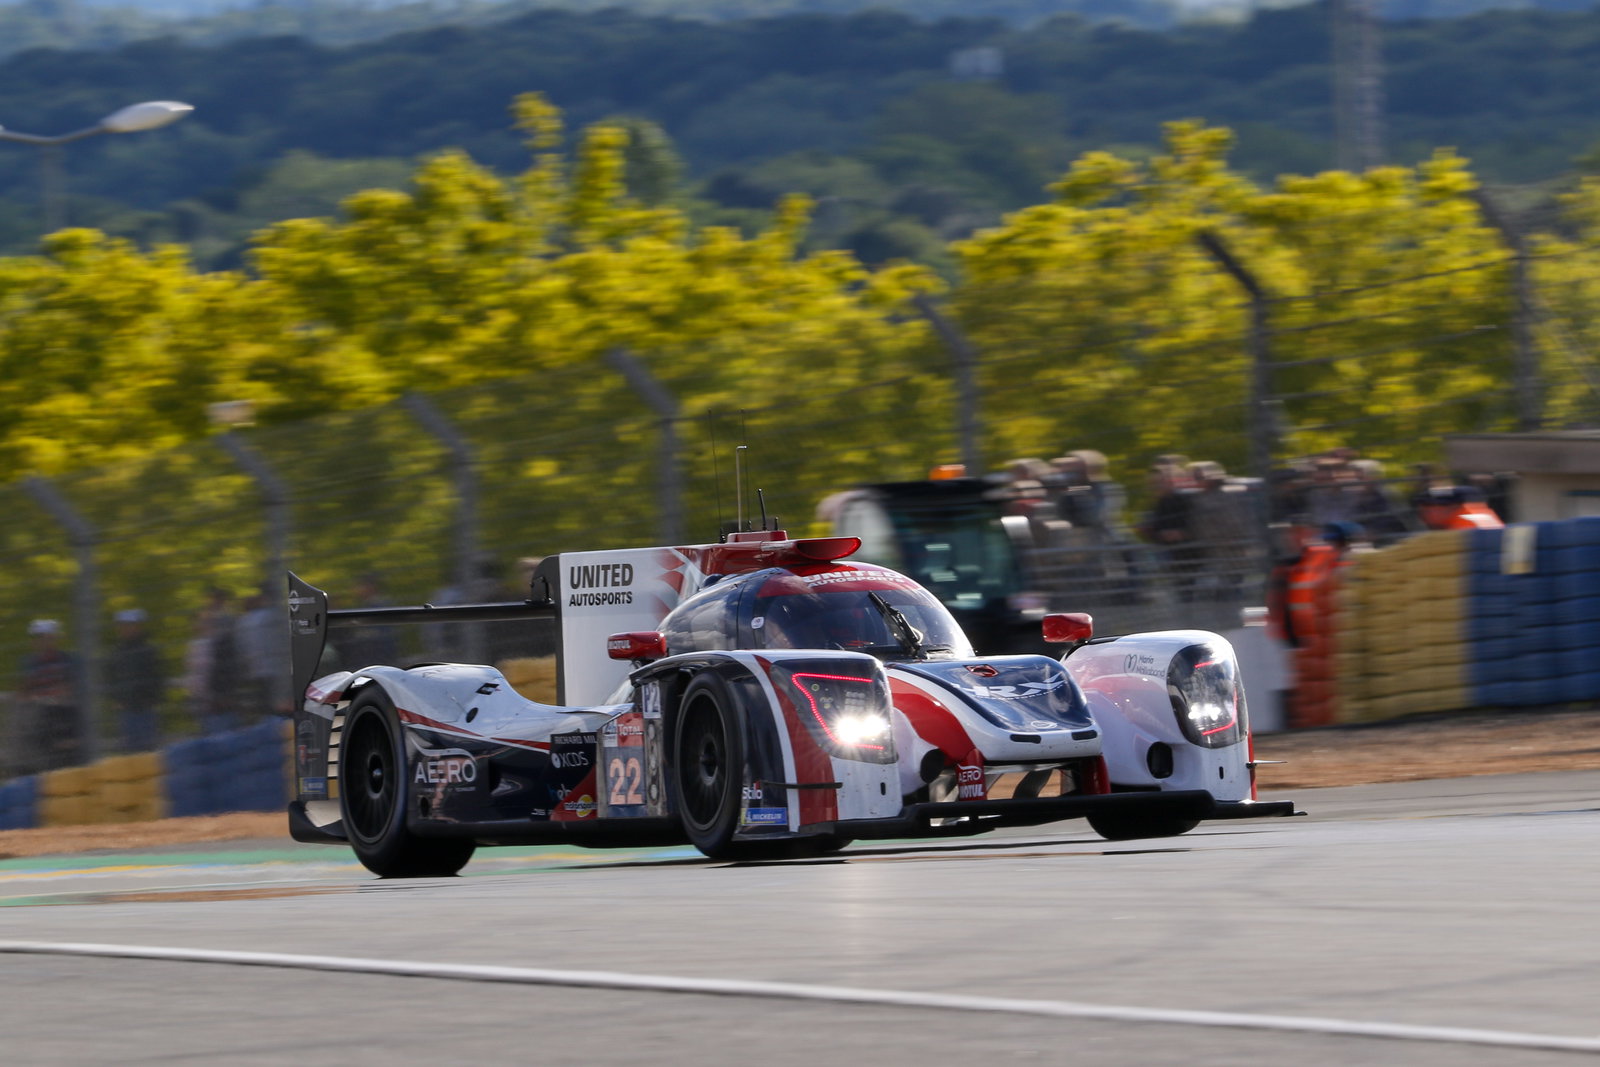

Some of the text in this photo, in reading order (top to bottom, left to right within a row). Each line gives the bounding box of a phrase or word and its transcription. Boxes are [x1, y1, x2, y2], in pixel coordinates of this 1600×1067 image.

[570, 563, 633, 590] UNITED
[802, 570, 904, 583] UNITED
[569, 591, 632, 607] AUTOSPORTS
[617, 724, 644, 737] TOTAL
[414, 760, 477, 784] AERO
[959, 770, 982, 783] AERO
[609, 757, 643, 805] 22
[959, 784, 985, 799] MOTUL
